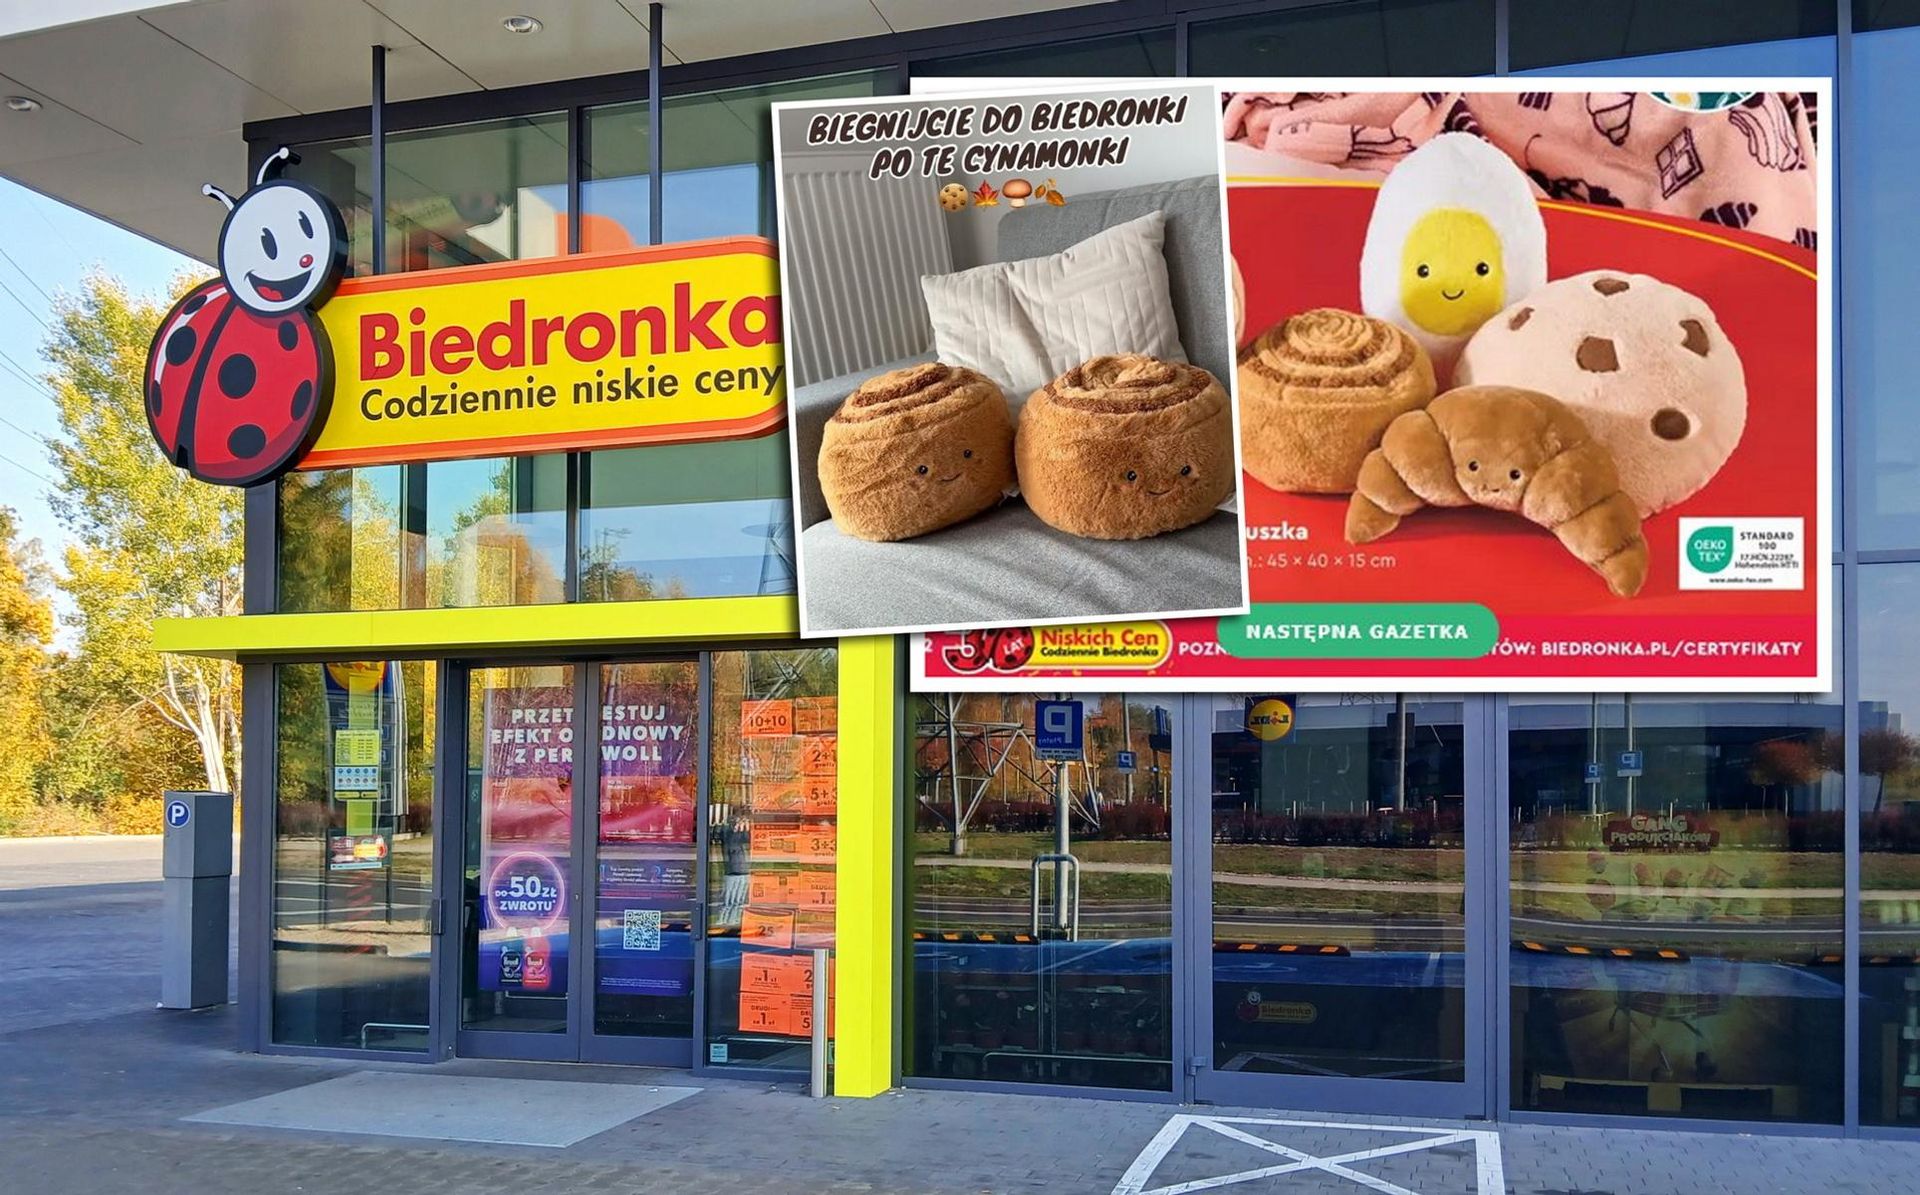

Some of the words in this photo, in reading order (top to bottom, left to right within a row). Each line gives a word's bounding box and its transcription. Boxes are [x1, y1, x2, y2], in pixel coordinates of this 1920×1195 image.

[360, 282, 782, 381] Biedronka
[361, 376, 556, 421] Codziennie
[573, 365, 679, 404] niskie
[695, 364, 785, 396] ceny
[492, 729, 552, 744] EFEKT
[515, 748, 526, 764] Z
[171, 805, 185, 824] P
[1631, 814, 1687, 832] GANG
[509, 876, 541, 897] 50
